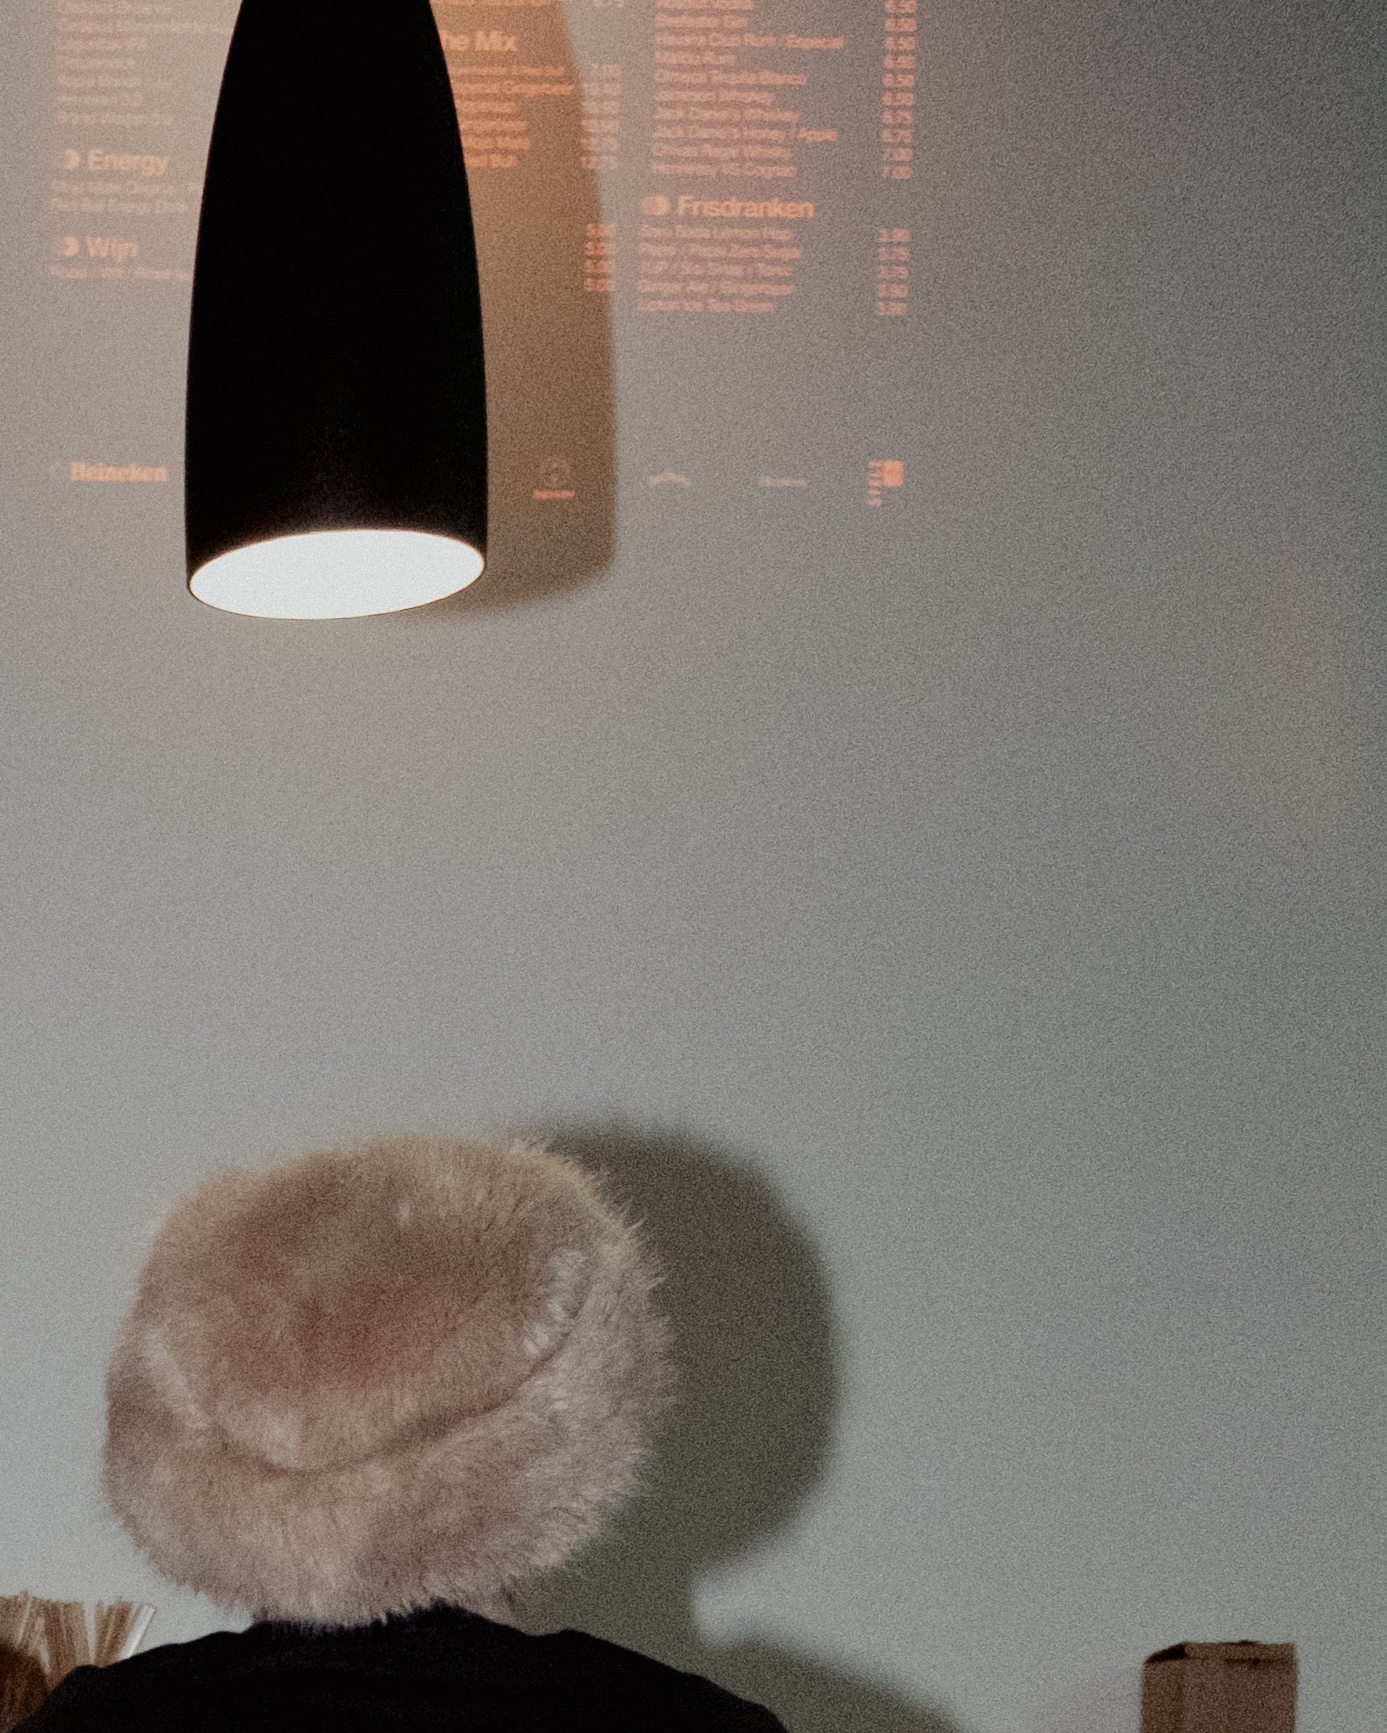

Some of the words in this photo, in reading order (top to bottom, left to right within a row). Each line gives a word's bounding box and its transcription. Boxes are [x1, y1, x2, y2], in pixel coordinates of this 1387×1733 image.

[475, 30, 518, 52] Mix
[88, 149, 169, 177] Energy
[677, 194, 815, 218] Frisdranken
[86, 236, 138, 262] Wijn
[70, 461, 168, 483] Heineken
